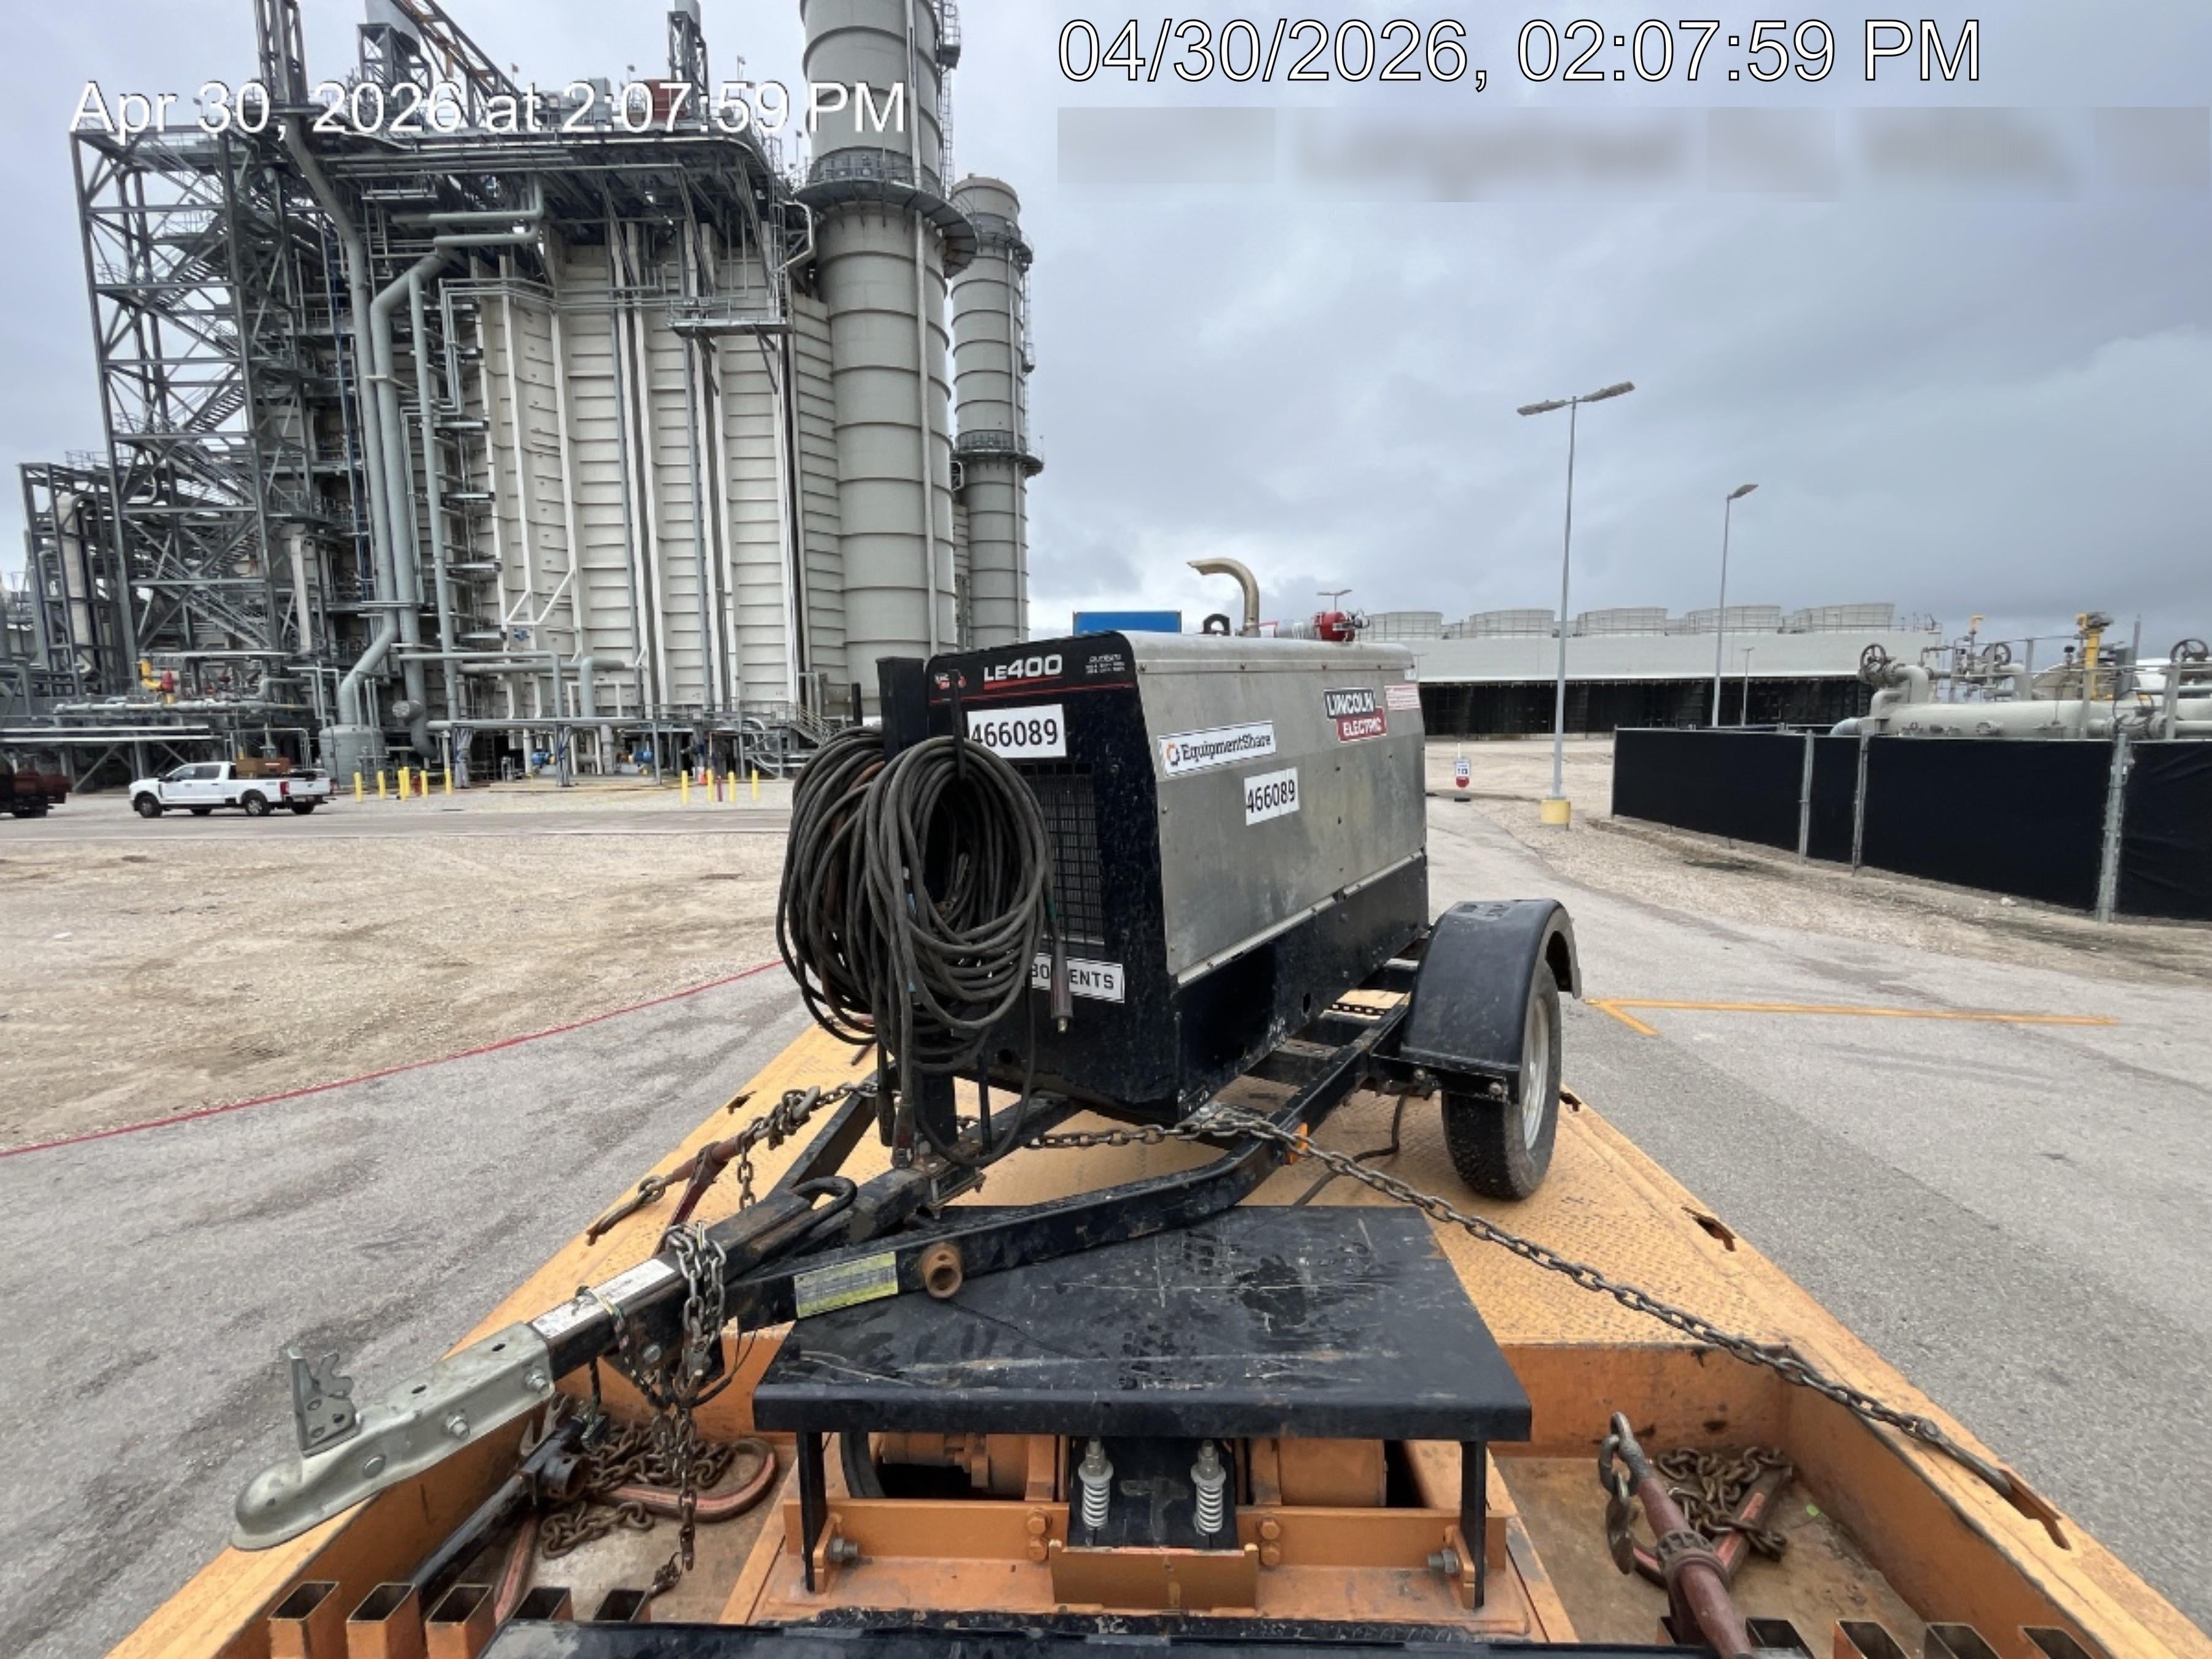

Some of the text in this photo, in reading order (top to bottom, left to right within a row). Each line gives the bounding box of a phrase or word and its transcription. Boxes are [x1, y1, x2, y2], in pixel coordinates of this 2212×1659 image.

[984, 654, 1062, 681] LE400
[1327, 692, 1374, 716] LINCOLN
[970, 718, 1057, 747] 466089
[1343, 716, 1382, 737] ELECTRIC
[1180, 733, 1271, 763] EquipmentShare
[1247, 779, 1295, 813] 466089
